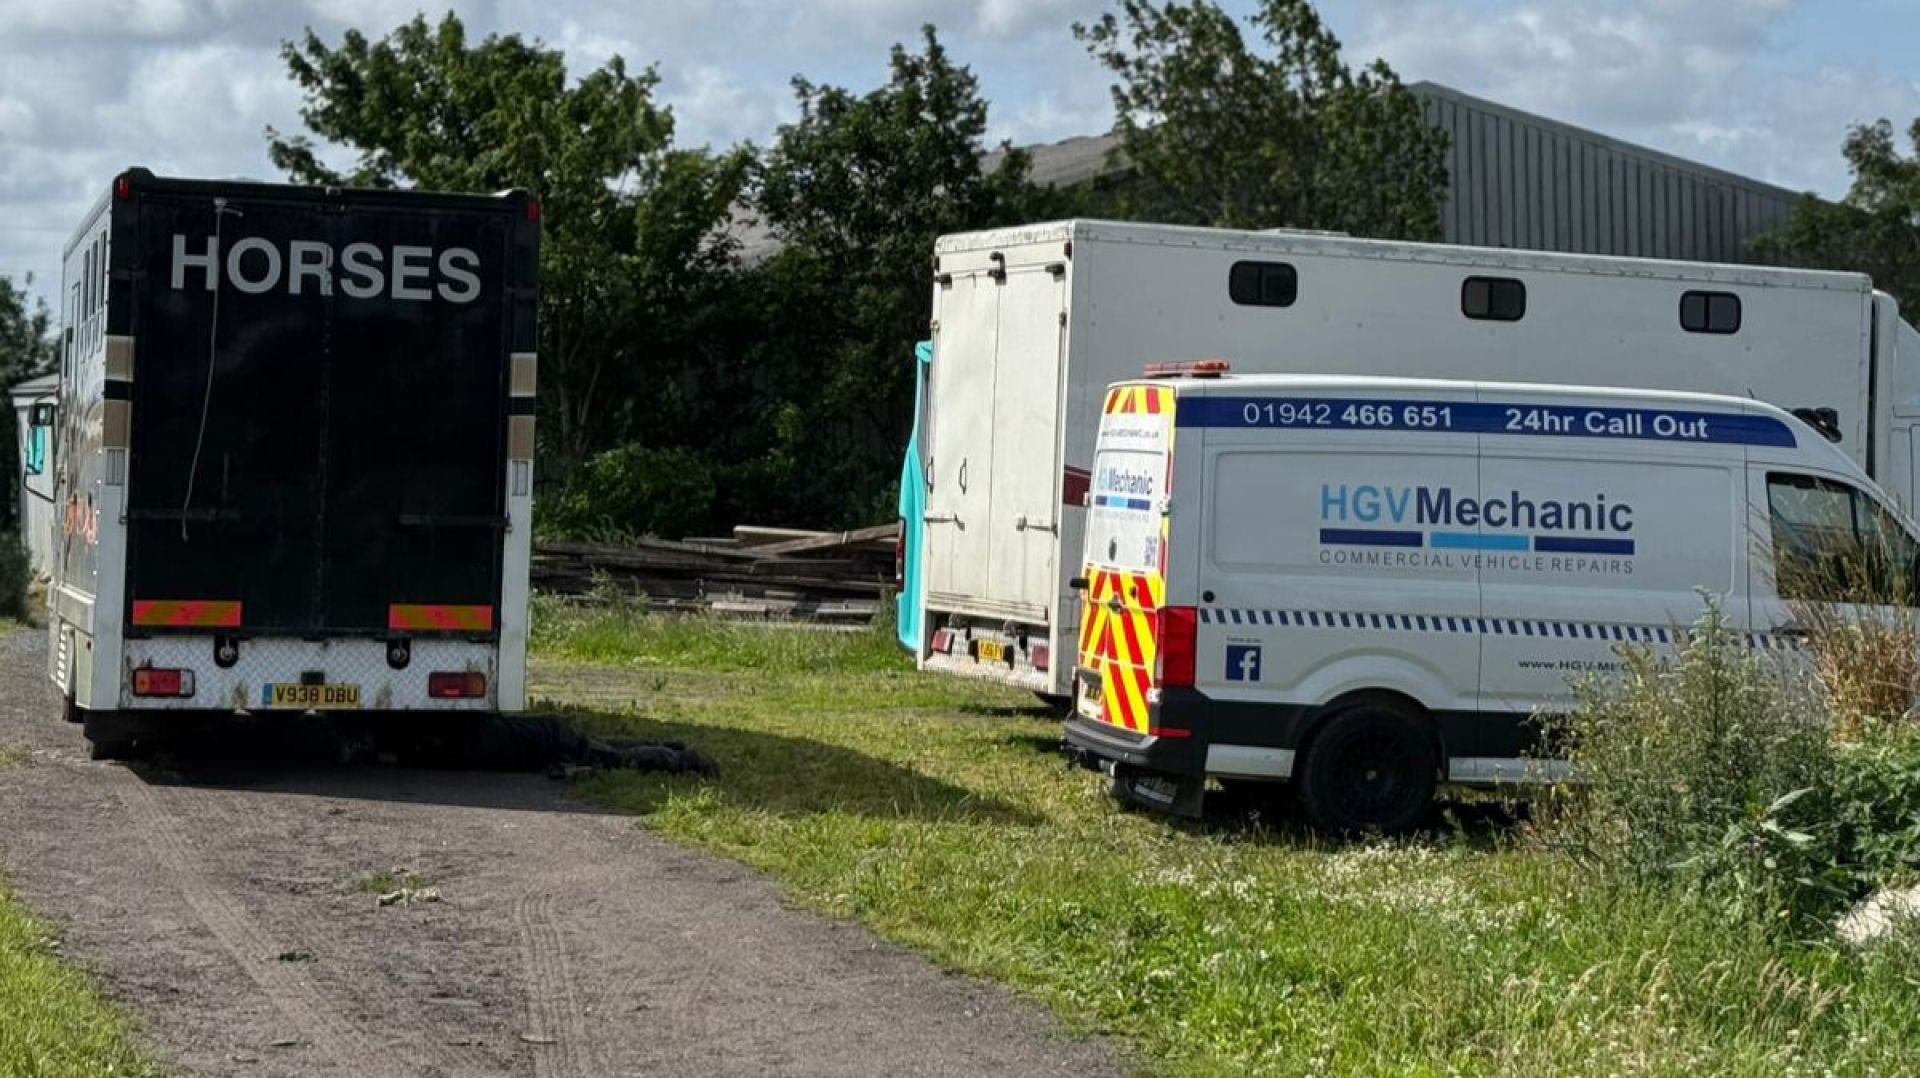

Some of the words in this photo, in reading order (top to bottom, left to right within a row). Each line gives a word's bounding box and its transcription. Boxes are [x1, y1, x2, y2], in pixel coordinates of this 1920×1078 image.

[171, 234, 482, 303] HORSES
[1243, 402, 1332, 425] 01942
[1341, 404, 1394, 426] 466
[1403, 406, 1452, 428] 651
[1505, 408, 1574, 431] 24hr
[1584, 411, 1643, 434] Call
[1653, 415, 1708, 438] Out
[1319, 550, 1454, 567] COMMERCIAL
[1461, 554, 1544, 571] VEHICLE
[1551, 557, 1633, 574] REPAIRS
[276, 686, 319, 702] V938
[325, 687, 358, 703] DBU
